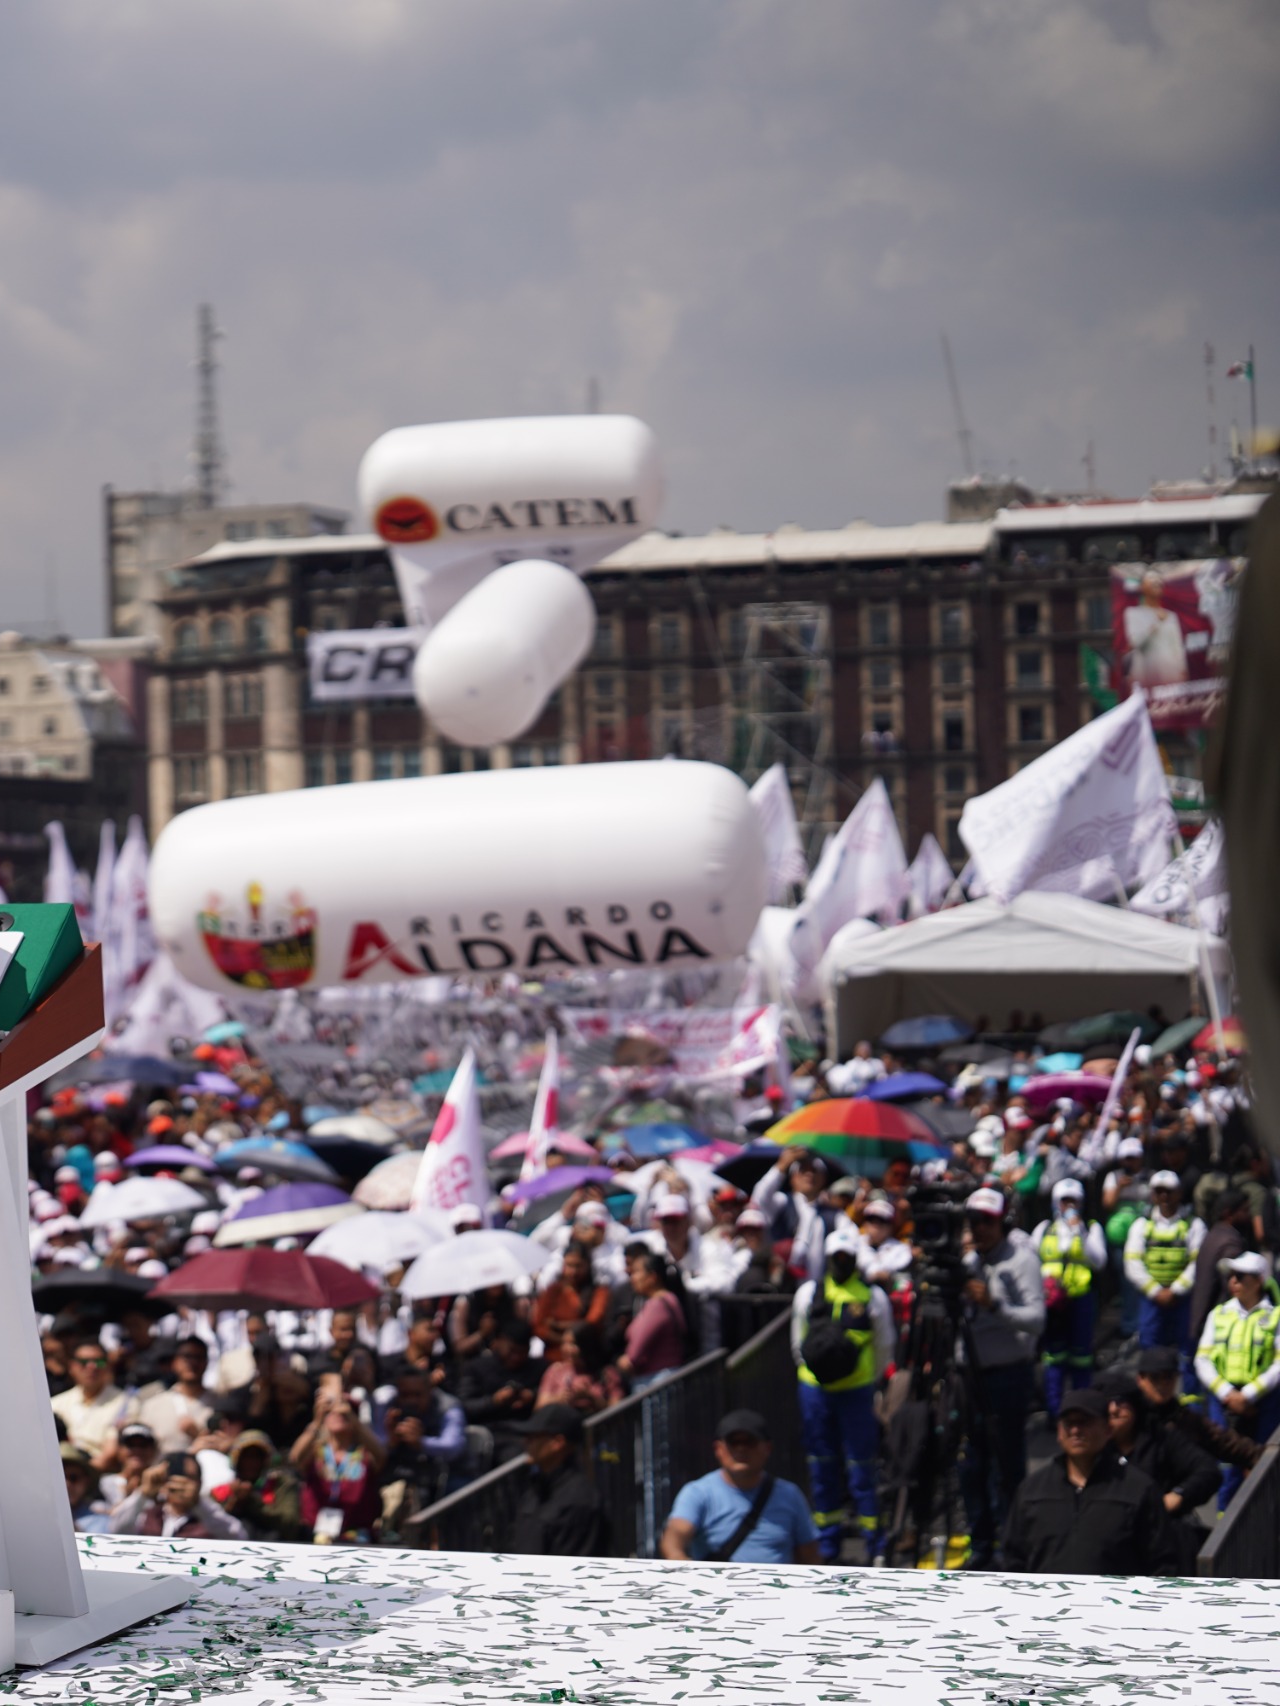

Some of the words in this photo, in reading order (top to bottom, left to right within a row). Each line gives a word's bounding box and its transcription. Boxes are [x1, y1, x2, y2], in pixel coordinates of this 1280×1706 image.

[445, 497, 639, 533] CATEM
[410, 899, 673, 936] RICARDO
[341, 920, 712, 979] ALDANA
